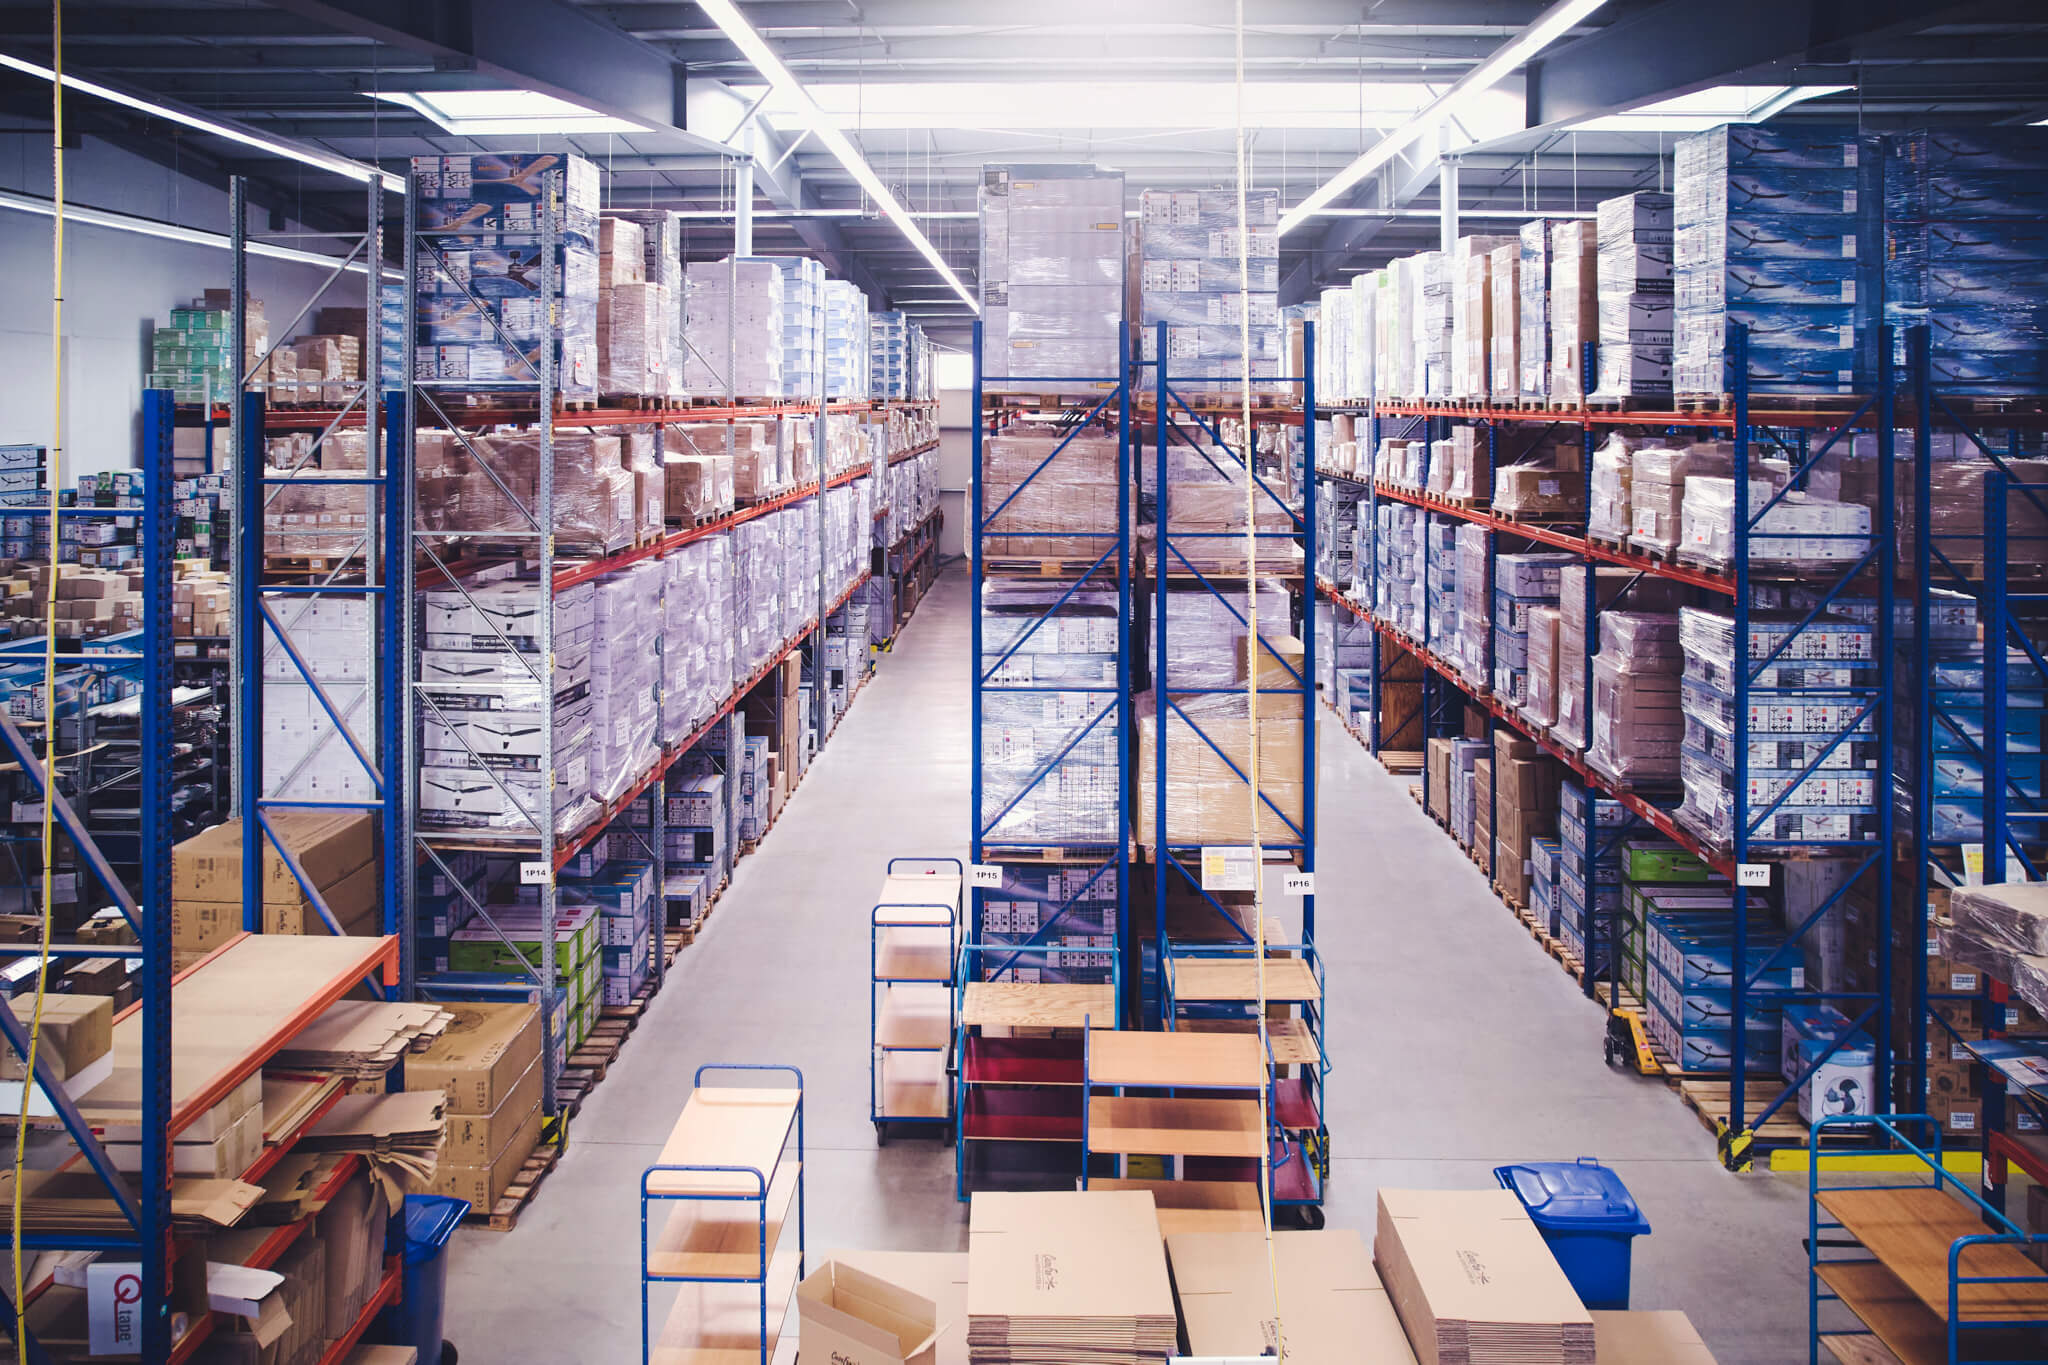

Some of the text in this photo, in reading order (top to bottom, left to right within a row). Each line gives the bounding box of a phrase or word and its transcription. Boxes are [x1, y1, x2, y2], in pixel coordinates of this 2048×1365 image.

[525, 869, 547, 877] 1P14
[975, 871, 998, 880] 1P15
[1743, 870, 1766, 879] 1P17
[1287, 880, 1311, 888] 1P16
